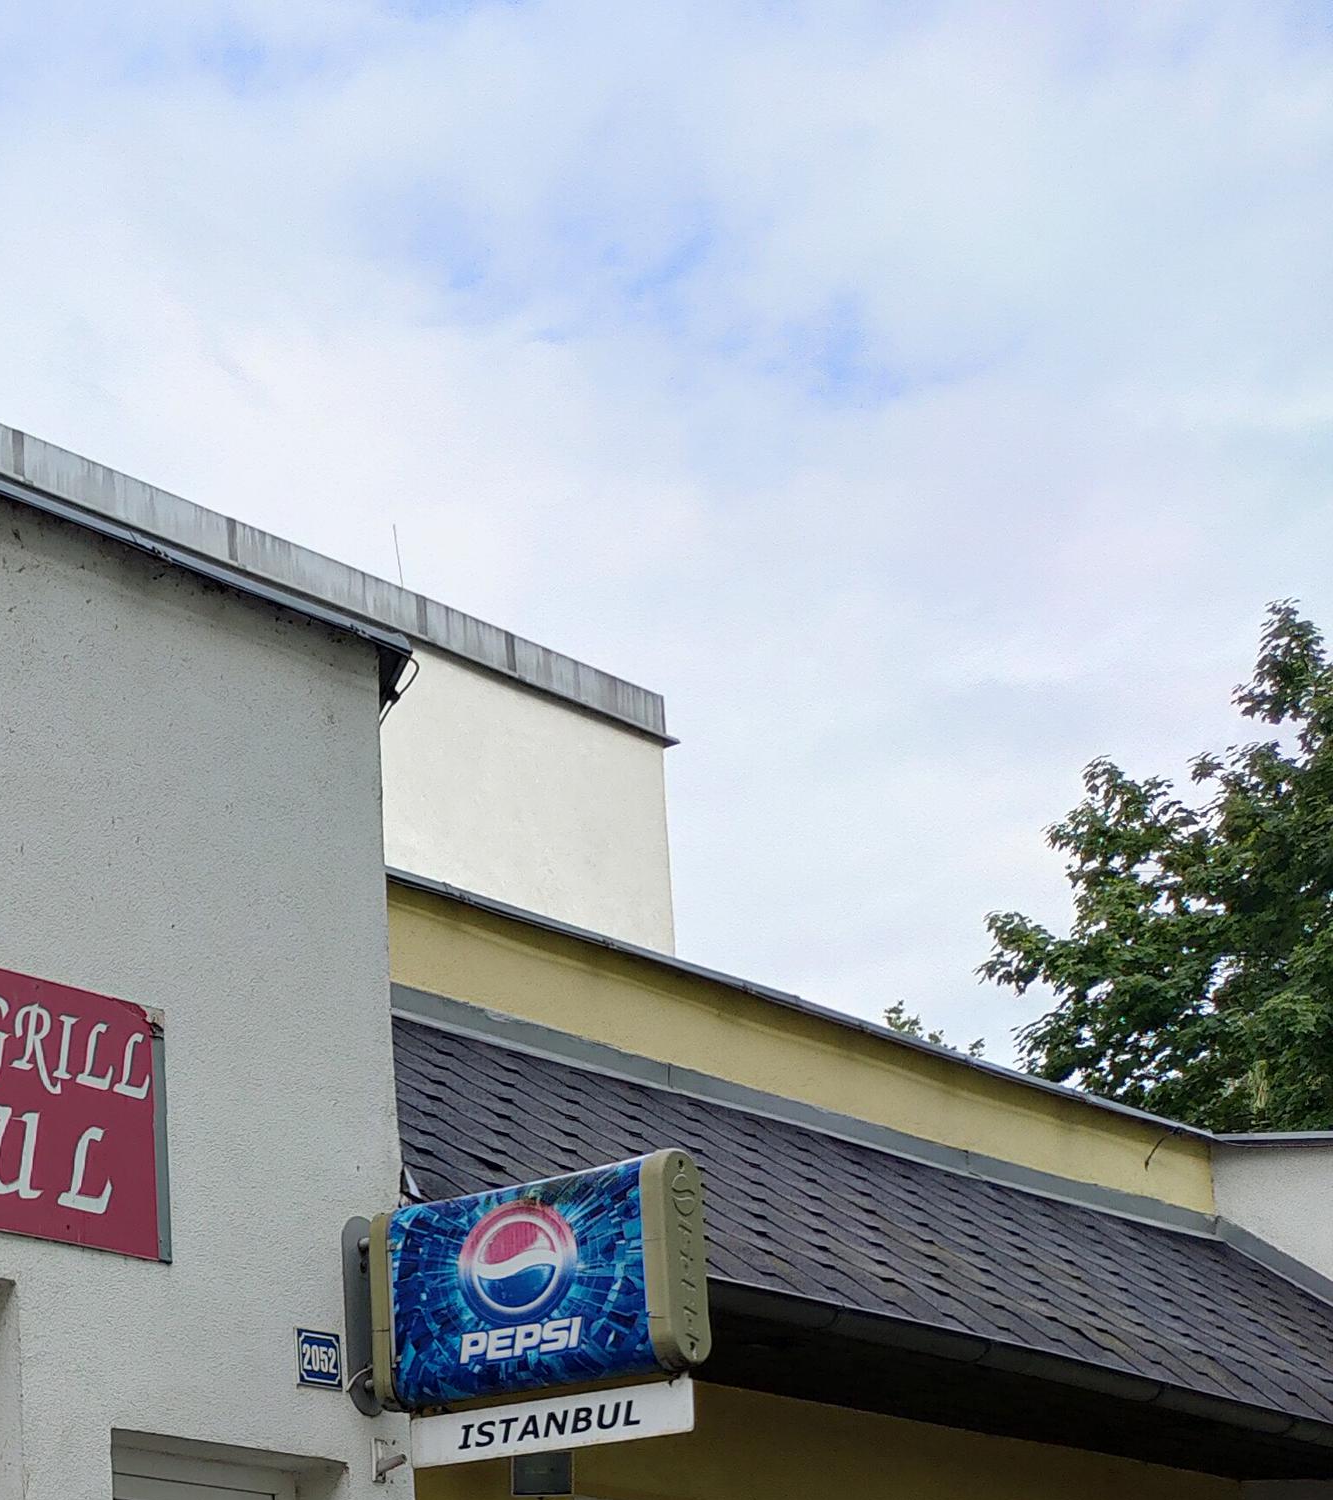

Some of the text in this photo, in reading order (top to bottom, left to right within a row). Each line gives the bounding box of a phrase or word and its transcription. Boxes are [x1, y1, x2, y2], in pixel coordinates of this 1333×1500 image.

[301, 1342, 338, 1375] 2052
[459, 1316, 583, 1365] PEPSI
[457, 1399, 642, 1450] ISTANBUL
